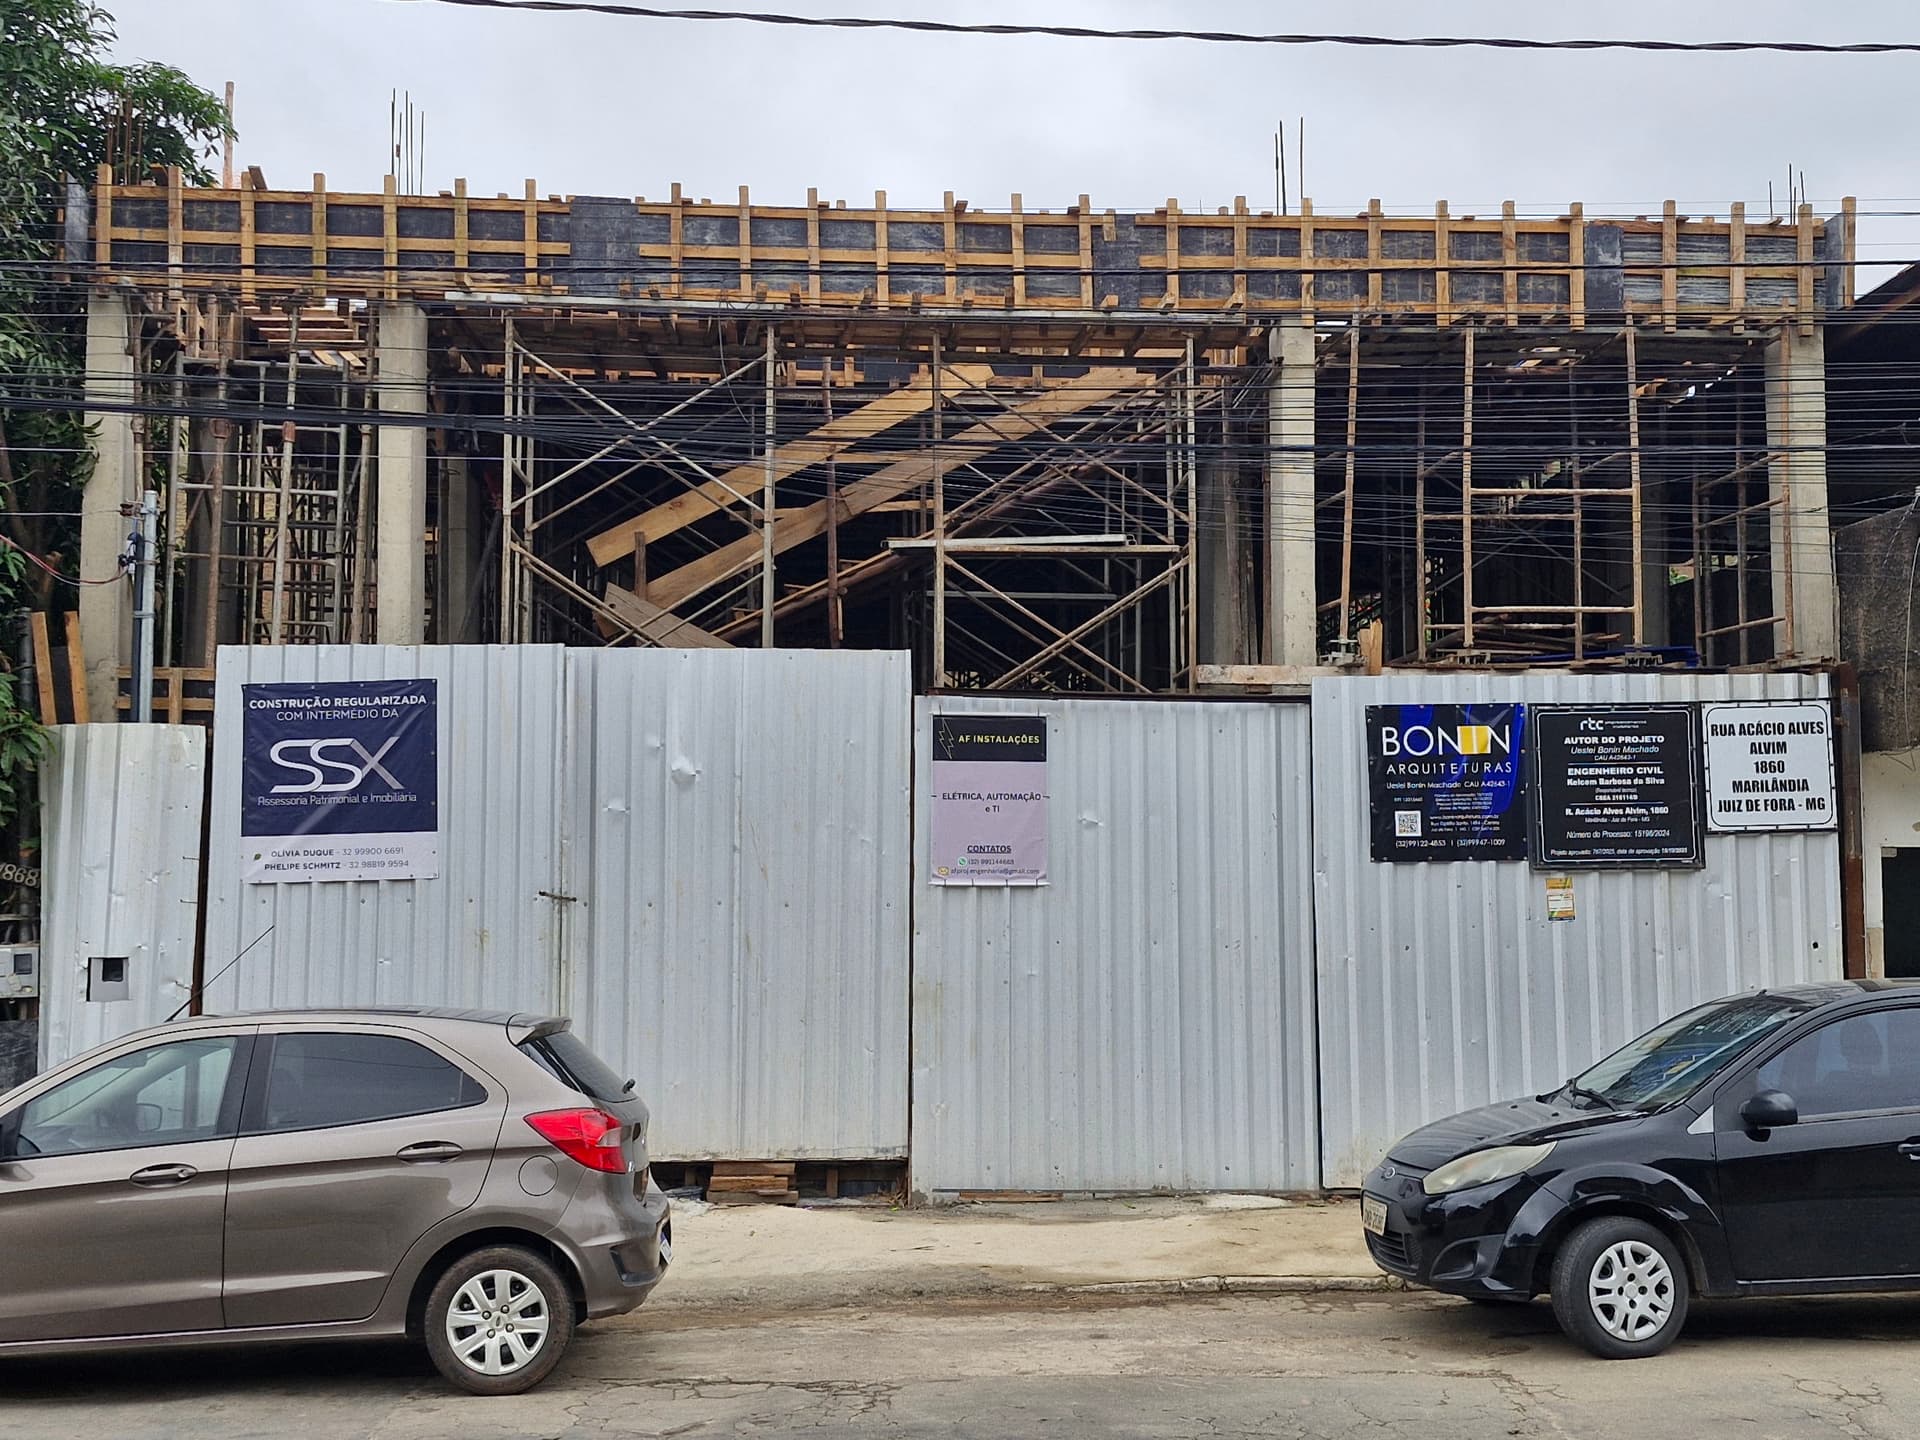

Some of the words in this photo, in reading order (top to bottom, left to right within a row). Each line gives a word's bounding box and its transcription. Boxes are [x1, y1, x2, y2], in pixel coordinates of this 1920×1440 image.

[250, 696, 331, 709] CONSTRUÇÃO
[334, 695, 427, 707] REGULARIZADA
[276, 712, 303, 721] COM
[306, 708, 378, 720] INTERMÉDIO
[382, 709, 399, 718] DA
[1580, 717, 1604, 731] rtc
[1711, 723, 1736, 736] RUA
[1738, 720, 1785, 736] ACÁCIO
[1788, 721, 1825, 735] ALVES
[958, 735, 971, 743] AF
[973, 734, 1040, 745] INSTALAÇÕES
[1382, 724, 1510, 756] BONIN
[1564, 736, 1599, 745] AUTOR
[1601, 736, 1616, 744] DO
[1618, 735, 1665, 744] PROJETO
[1597, 746, 1621, 754] Bonin
[1622, 745, 1660, 753] Machado
[1749, 741, 1788, 755] ALVIM
[270, 736, 405, 793] SSX
[1386, 762, 1512, 775] ARQUITETURAS
[1753, 760, 1786, 774] 1860
[1567, 767, 1634, 776] ENGENHEIRO
[1636, 766, 1663, 775] CIVIL
[1407, 781, 1426, 789] Bonin
[1427, 780, 1462, 789] Machado
[1464, 780, 1479, 788] CAU
[1599, 777, 1632, 785] Barbosa
[1645, 777, 1665, 785] Silva
[1732, 777, 1810, 793] MARILÂNDIA
[257, 796, 308, 806] Assessoria
[310, 794, 360, 805] Patrimonial
[362, 795, 368, 803] e
[942, 792, 985, 802] ELÉTRICA,
[986, 791, 1041, 803] AUTOMAÇÃO
[992, 805, 1000, 813] TI
[1575, 807, 1601, 815] Acácio
[1602, 807, 1623, 815] Alves
[1625, 806, 1649, 816] Alvim,
[1718, 799, 1743, 813] JUIZ
[1745, 798, 1761, 812] DE
[1763, 798, 1796, 812] FORA
[1805, 797, 1826, 811] MG
[1566, 831, 1592, 839] Número
[271, 849, 300, 858] OLÍVIA
[303, 849, 334, 857] DUQUE
[342, 848, 352, 856] 32
[354, 847, 382, 855] 99900
[384, 847, 404, 855] 6691
[967, 845, 1012, 854] CONTATOS
[264, 863, 300, 871] PHELIPE
[302, 862, 341, 870] SCHMITZ
[348, 861, 359, 869] 32
[387, 860, 409, 868] 9594
